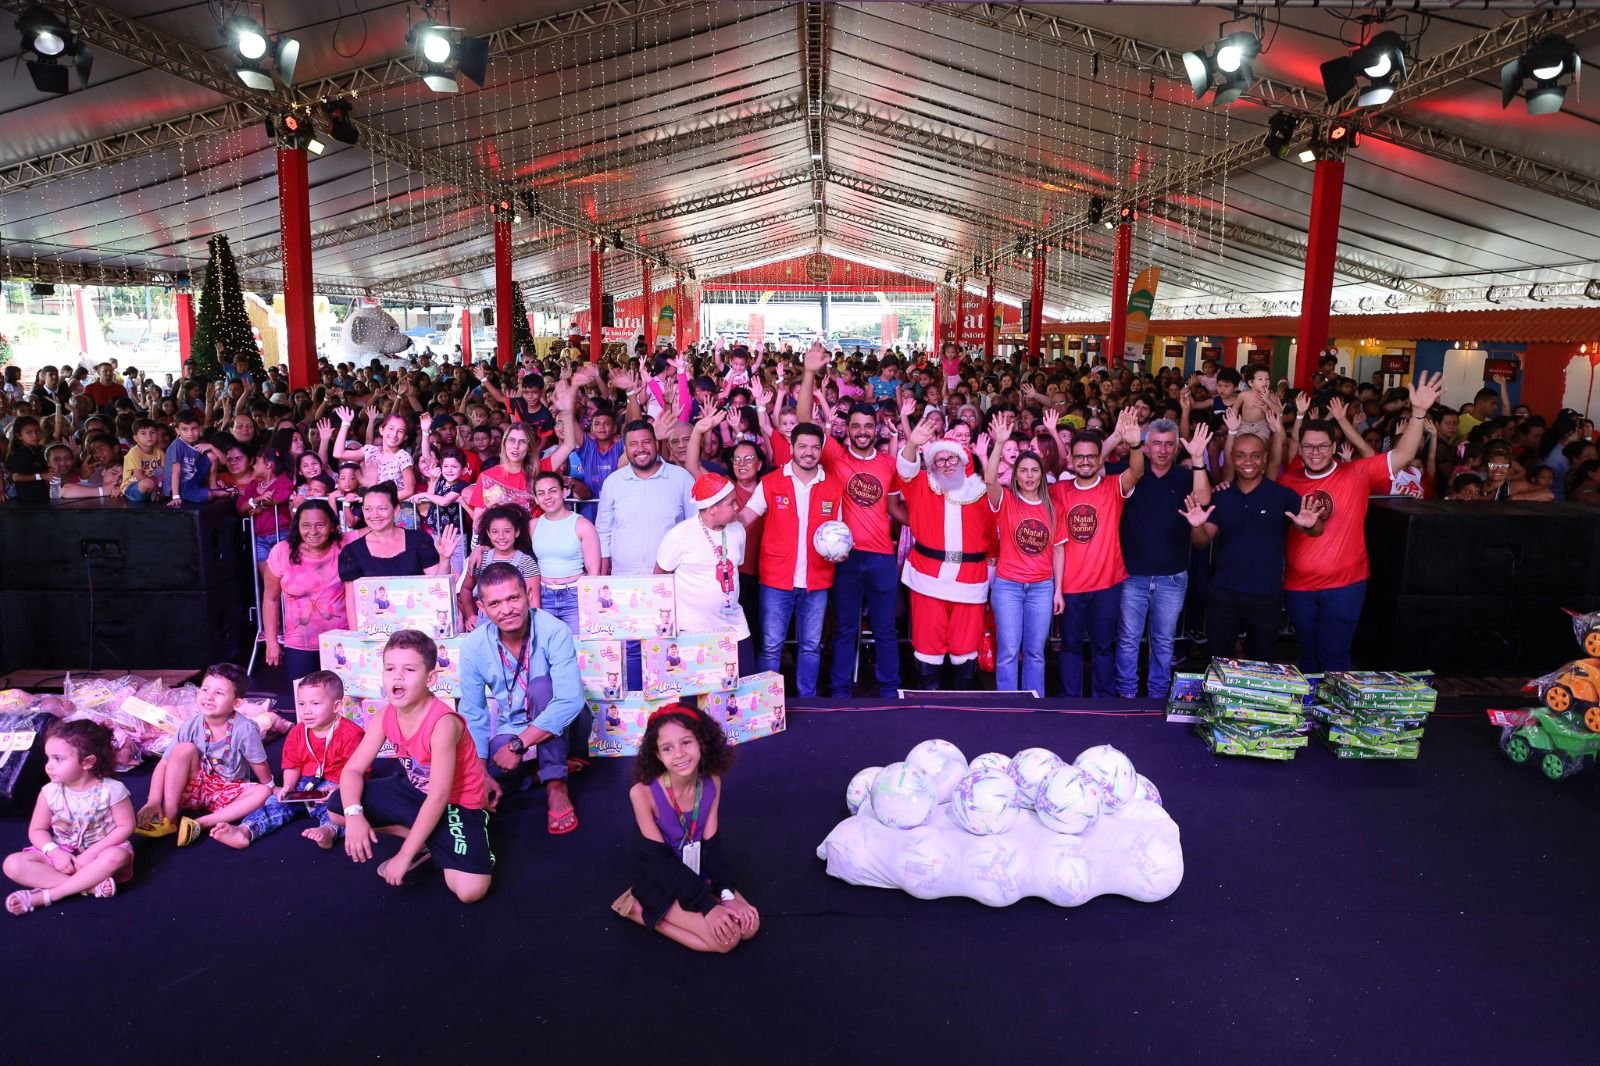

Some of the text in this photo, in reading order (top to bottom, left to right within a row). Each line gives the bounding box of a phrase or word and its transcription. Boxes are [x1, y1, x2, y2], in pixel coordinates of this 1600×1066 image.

[613, 314, 644, 329] atal
[1074, 514, 1094, 523] Natal
[1023, 527, 1044, 538] Natal
